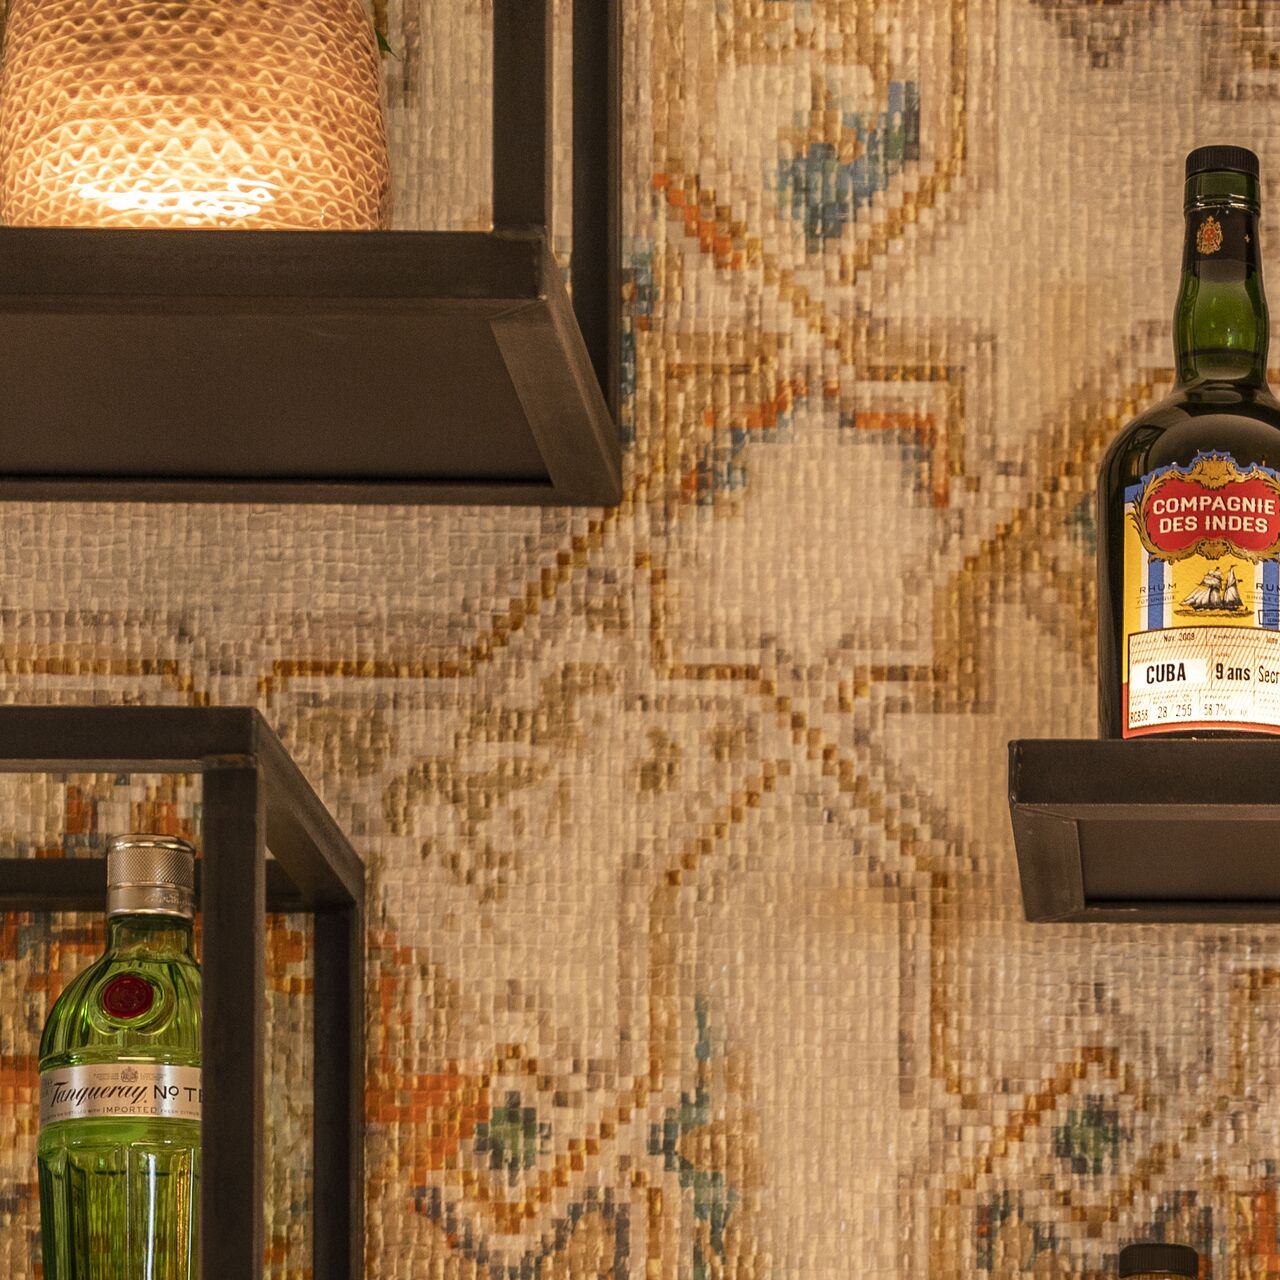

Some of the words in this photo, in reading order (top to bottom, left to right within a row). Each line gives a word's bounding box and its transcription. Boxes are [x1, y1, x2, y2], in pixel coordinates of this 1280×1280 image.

[1152, 495, 1276, 516] COMPAGNIE
[1159, 516, 1198, 534] DES
[1204, 516, 1268, 534] INDES
[1139, 582, 1177, 594] RHUM
[1146, 662, 1187, 684] CUBA
[1215, 662, 1224, 680] 9
[1227, 665, 1251, 681] ans
[50, 1081, 147, 1108] Tanqueray
[102, 1106, 158, 1114] IMPORTED
